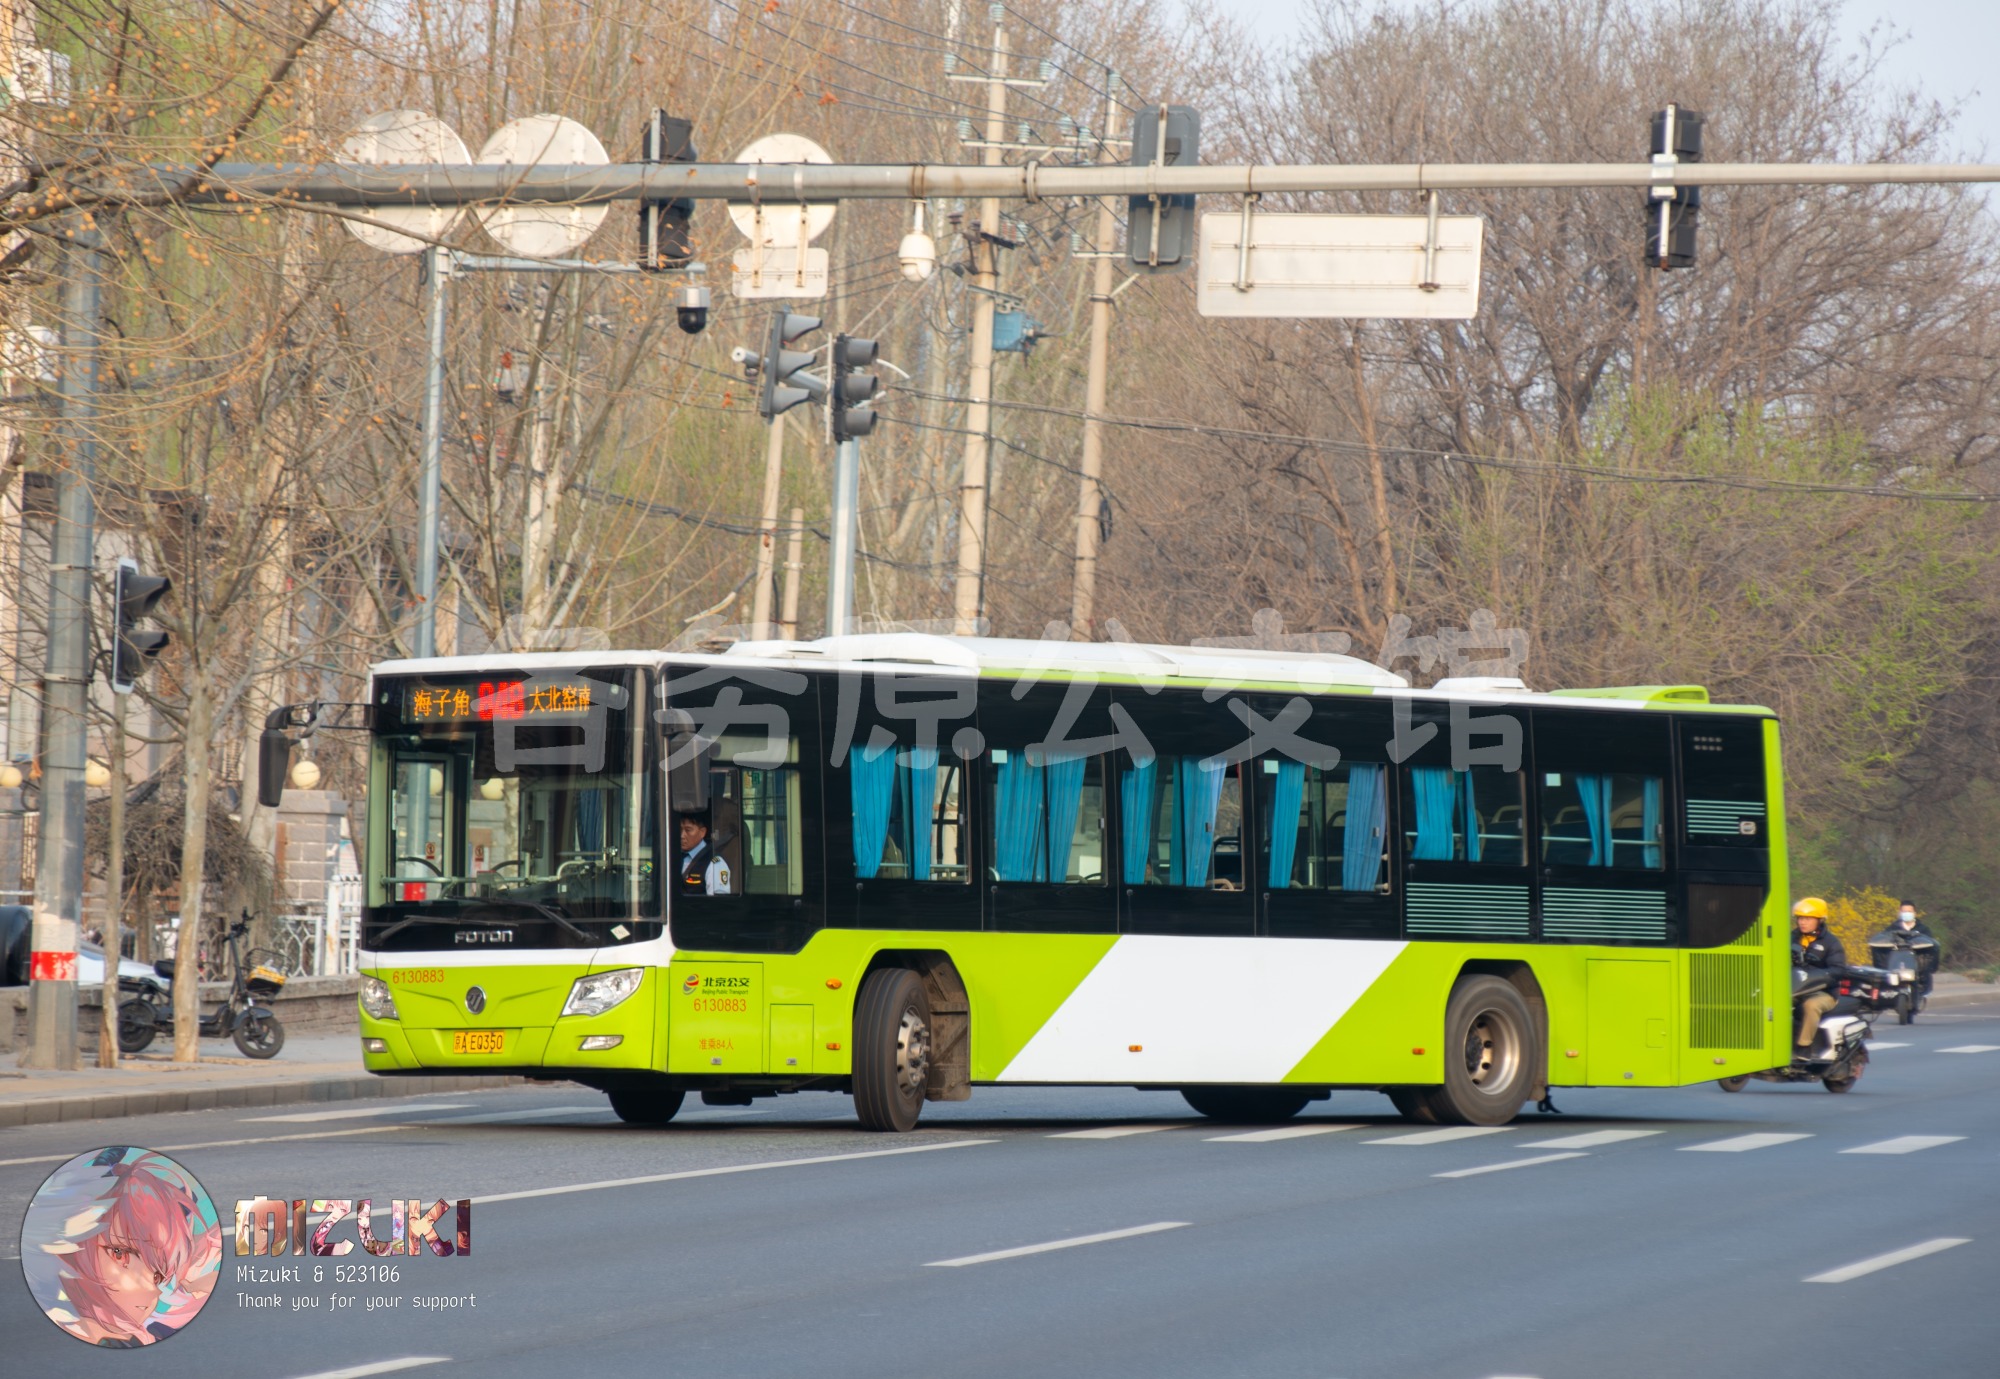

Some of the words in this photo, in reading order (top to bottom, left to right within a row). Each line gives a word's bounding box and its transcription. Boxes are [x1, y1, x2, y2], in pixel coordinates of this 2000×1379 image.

[414, 689, 470, 717] 海子角
[529, 684, 591, 714] 大北窑南
[454, 930, 513, 943] FOTON
[392, 969, 445, 984] 6130883
[703, 977, 750, 987] 北京公交
[693, 998, 747, 1012] 6130883
